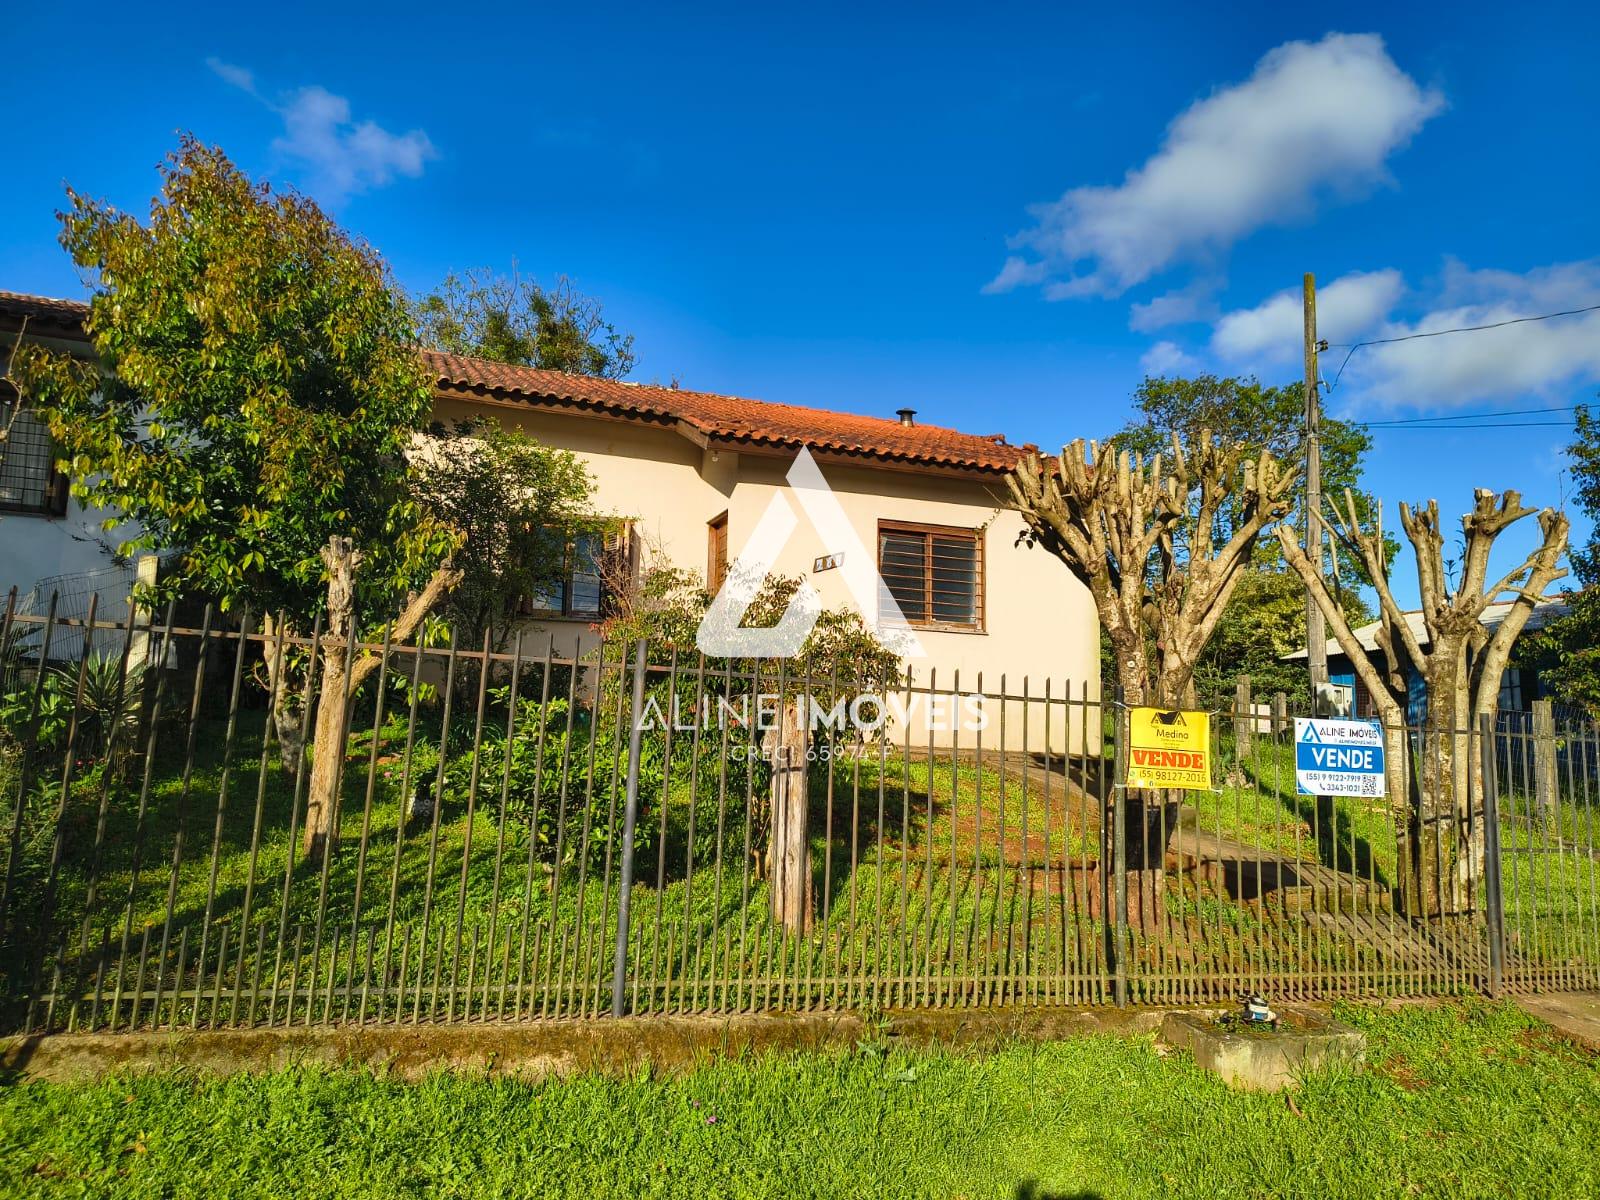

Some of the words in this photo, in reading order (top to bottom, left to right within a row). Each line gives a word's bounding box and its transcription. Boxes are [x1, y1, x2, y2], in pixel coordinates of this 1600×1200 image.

[1157, 729, 1189, 740] Medina
[1320, 728, 1346, 737] ALINE
[1350, 727, 1377, 739] IMÓVEIS
[1133, 750, 1204, 769] VENDE
[1312, 748, 1373, 769] VENDE
[1140, 770, 1153, 779] (55)
[1307, 773, 1320, 781] (55)
